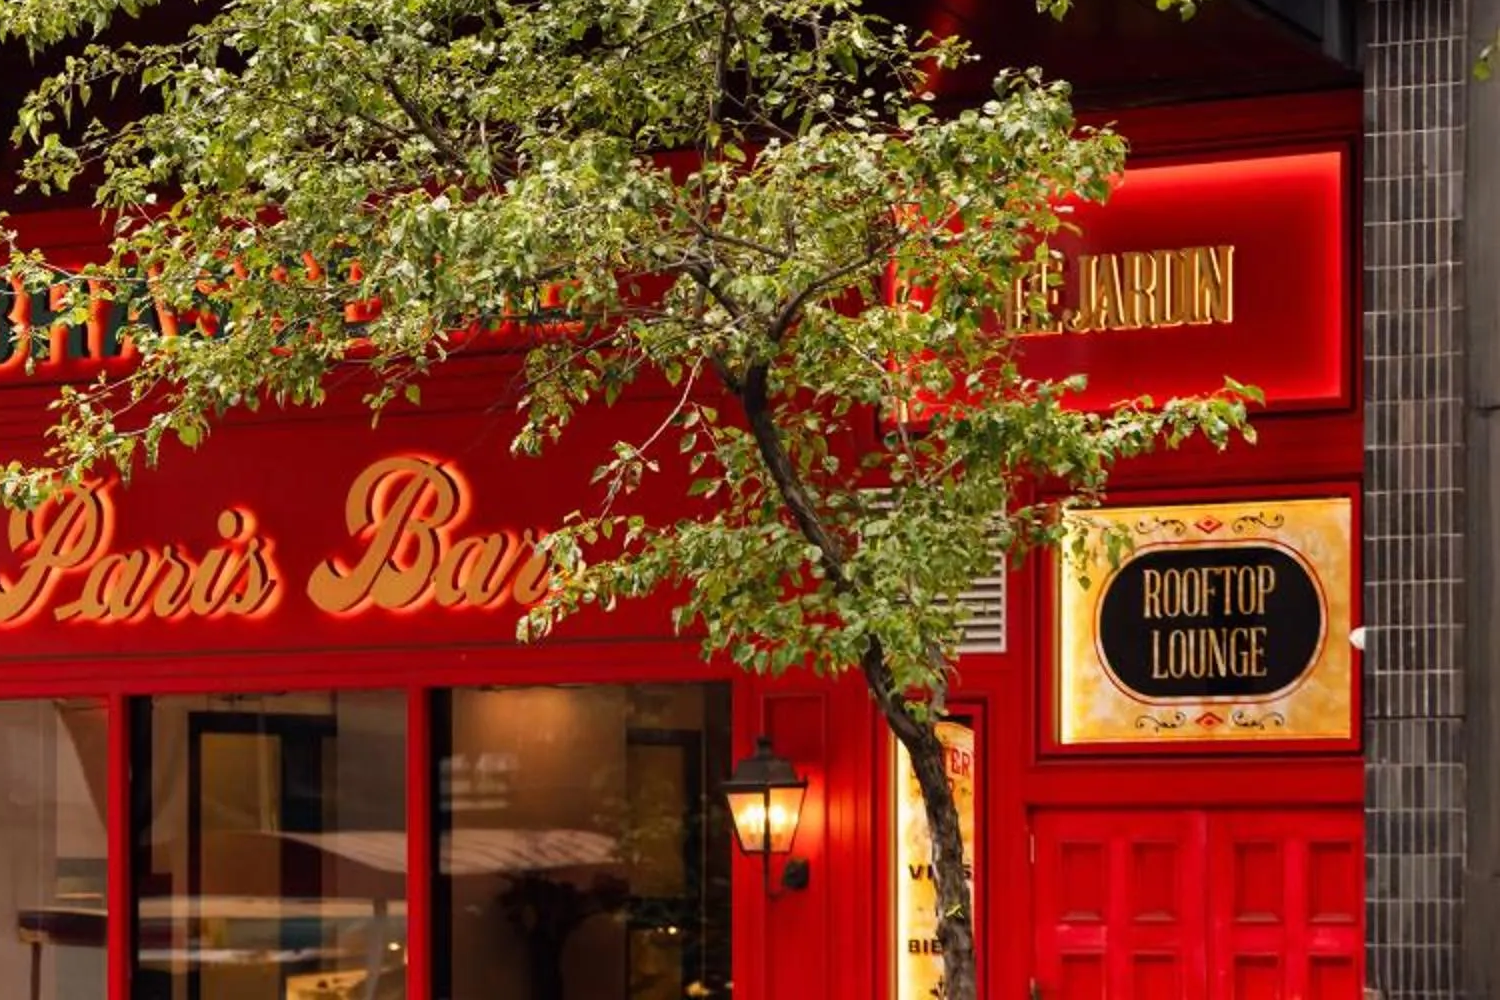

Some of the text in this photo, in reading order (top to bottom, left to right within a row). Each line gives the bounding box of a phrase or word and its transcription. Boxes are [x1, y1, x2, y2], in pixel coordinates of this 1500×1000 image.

[1063, 245, 1235, 334] JARDIN
[307, 455, 555, 612] Bar
[1142, 564, 1277, 620] ROOFTOP
[1151, 625, 1269, 680] LOUNGE
